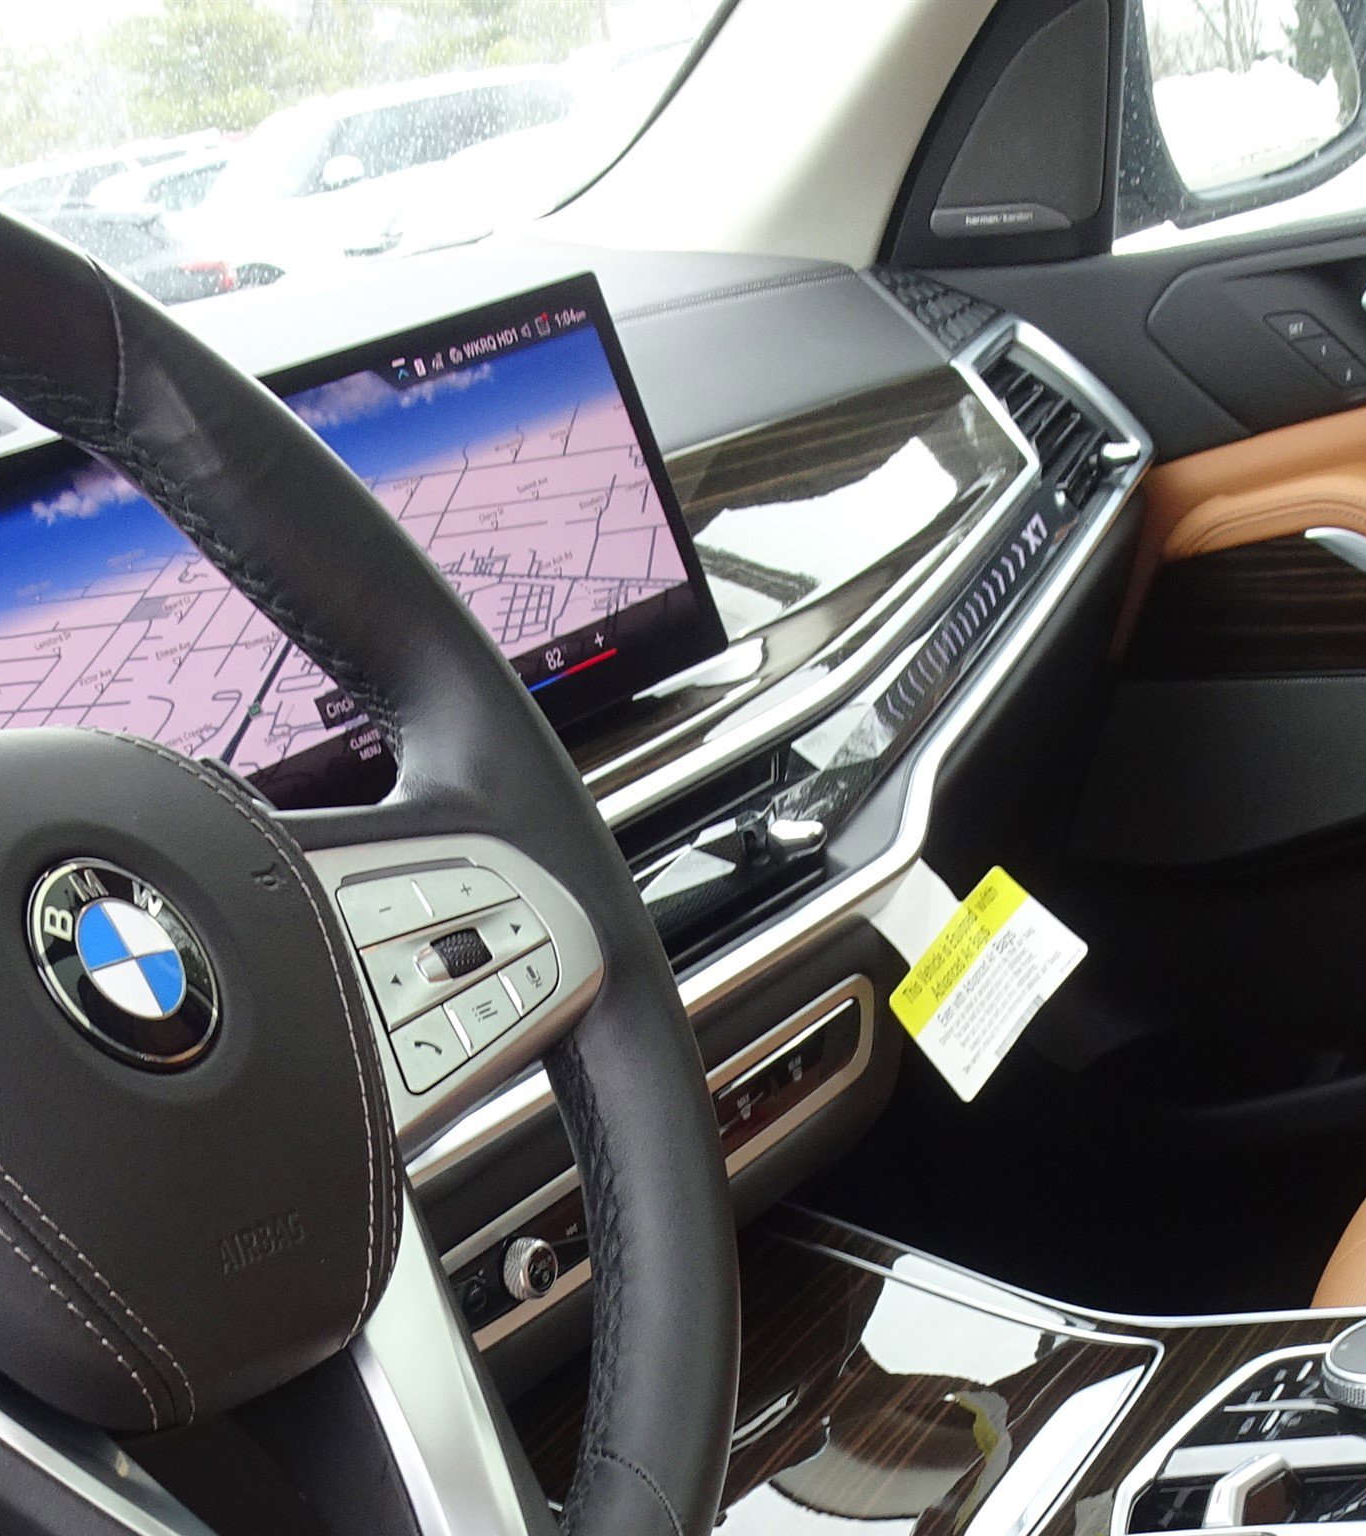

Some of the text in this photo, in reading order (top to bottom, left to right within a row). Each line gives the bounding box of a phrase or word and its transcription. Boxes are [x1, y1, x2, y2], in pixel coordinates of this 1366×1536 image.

[1021, 512, 1049, 556] X7
[359, 743, 382, 761] MENU
[43, 869, 164, 942] BMW
